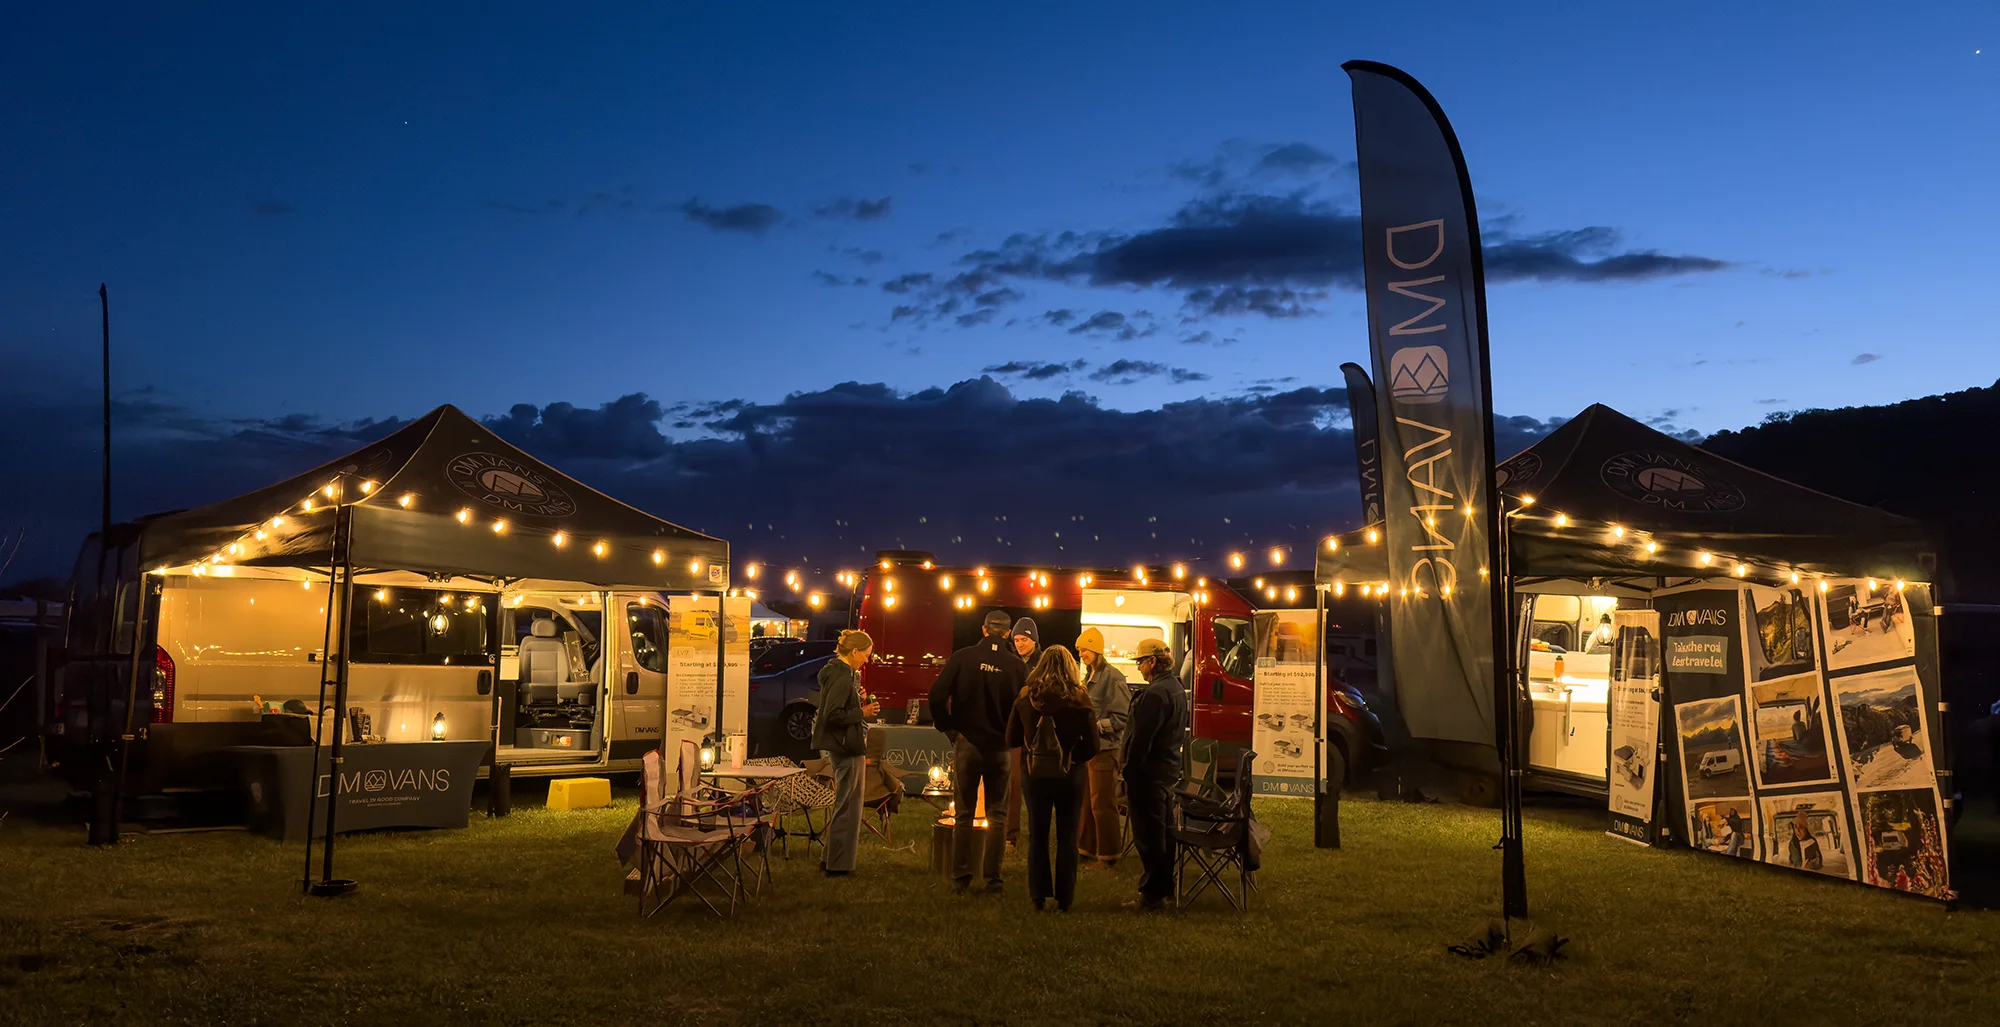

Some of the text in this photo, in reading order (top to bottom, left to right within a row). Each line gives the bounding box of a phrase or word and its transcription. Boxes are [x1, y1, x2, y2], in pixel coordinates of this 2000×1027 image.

[453, 455, 546, 484] DM VANS
[483, 493, 523, 512] DM
[1641, 493, 1685, 509] DM
[388, 768, 451, 792] VANS
[1263, 781, 1315, 793] DM VANS
